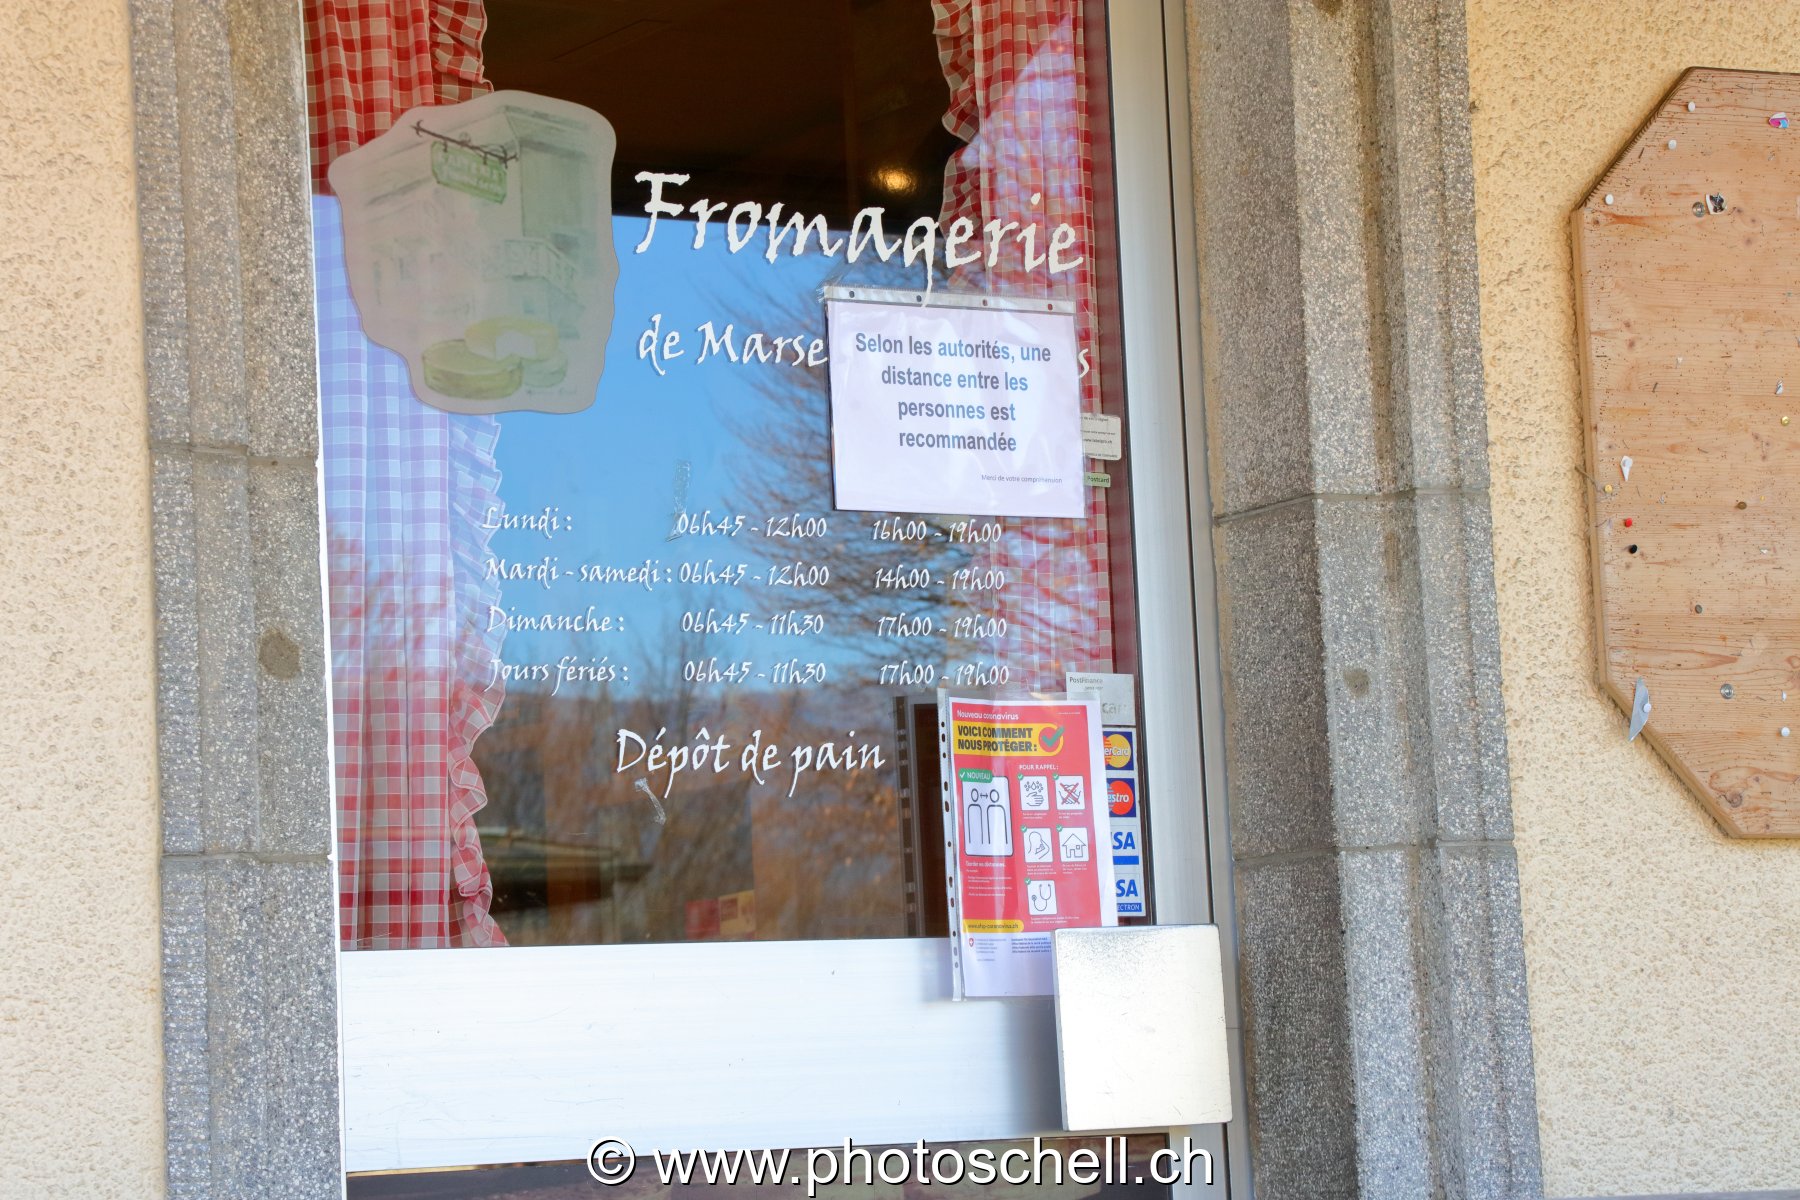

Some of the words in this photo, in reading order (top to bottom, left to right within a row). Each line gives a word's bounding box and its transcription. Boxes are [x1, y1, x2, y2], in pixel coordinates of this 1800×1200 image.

[634, 170, 1084, 308] Fromagerie
[638, 313, 685, 376] de
[697, 320, 828, 367] Marse
[855, 332, 903, 356] Selon
[909, 334, 933, 357] les
[937, 338, 1016, 363] autorités,
[1020, 345, 1051, 363] une
[881, 365, 952, 388] distance
[957, 371, 1000, 389] entre
[1004, 372, 1029, 391] les
[898, 401, 986, 421] personnes
[990, 404, 1016, 421] est
[899, 430, 1017, 452] recommandée
[677, 510, 746, 536] 06h45
[765, 513, 828, 539] 12h00
[872, 516, 928, 540] 16h00
[948, 518, 1002, 543] 19h00
[485, 556, 560, 589] Mardi
[678, 559, 747, 585] 06h45
[767, 561, 830, 587] 12h00
[874, 564, 930, 591] 14h00
[950, 566, 1005, 592] 19h00
[681, 608, 749, 635] 06h45
[769, 610, 825, 636] 11h30
[876, 612, 933, 638] 17h00
[953, 613, 1007, 640] 19h00
[484, 658, 550, 694] Jours
[683, 657, 751, 684] 06h45
[770, 658, 827, 684] 11h30
[878, 660, 936, 686] 17h00
[955, 661, 1010, 686] 19h00
[957, 709, 983, 719] Nouveau
[983, 712, 1019, 720] coronavirus
[958, 725, 982, 737] VOICI
[982, 727, 1033, 739] COMMENT
[958, 739, 982, 750] NOUS
[1104, 748, 1130, 757] erCard
[615, 726, 731, 799] Dépôt
[740, 729, 783, 785] de
[786, 731, 886, 798] pain
[966, 771, 991, 780] NOUVEAU
[1107, 793, 1129, 803] estro
[1112, 831, 1136, 850] SA
[1115, 879, 1138, 898] SA
[1117, 903, 1141, 912] ECTRON
